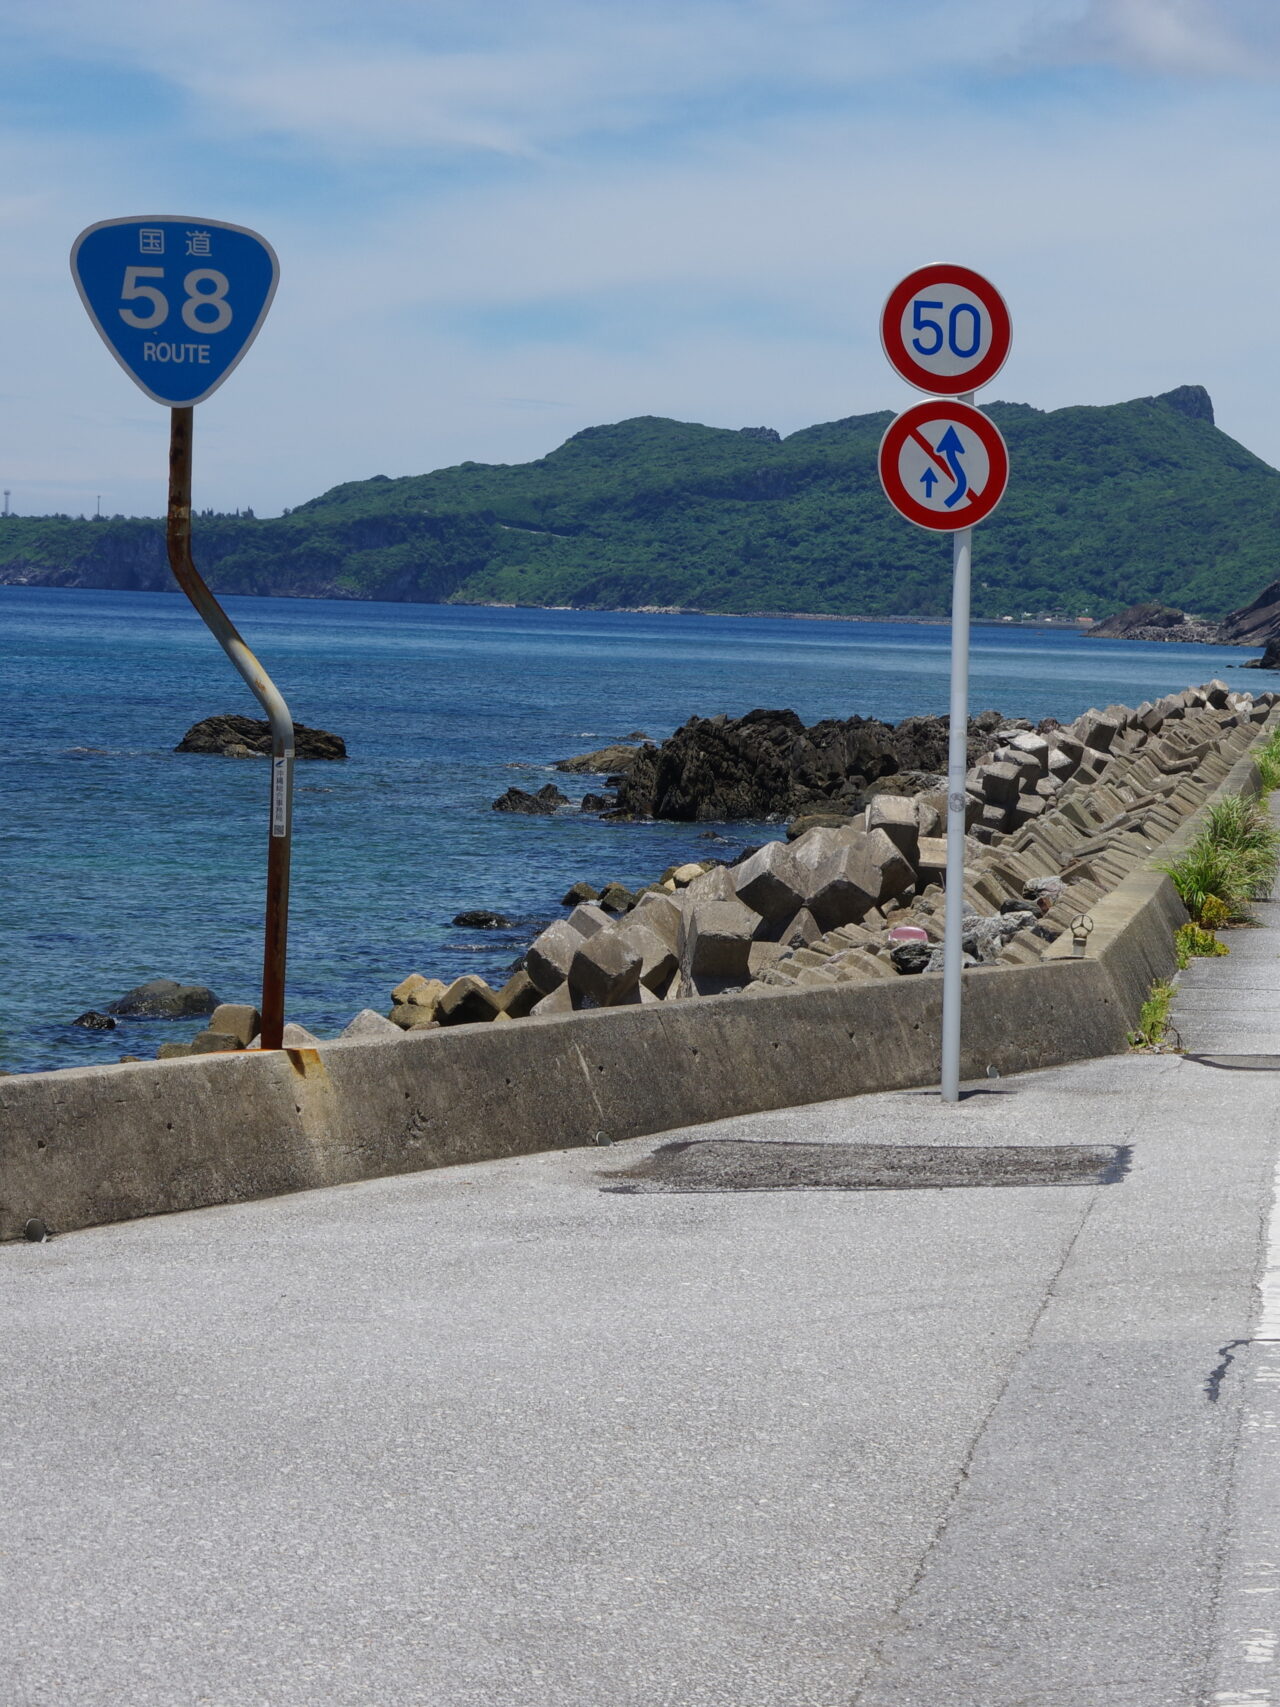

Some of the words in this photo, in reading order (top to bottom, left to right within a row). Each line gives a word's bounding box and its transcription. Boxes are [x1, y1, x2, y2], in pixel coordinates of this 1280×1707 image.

[139, 228, 212, 257] 国道
[118, 265, 233, 334] 58
[912, 300, 981, 358] 50
[143, 342, 211, 364] ROUTE
